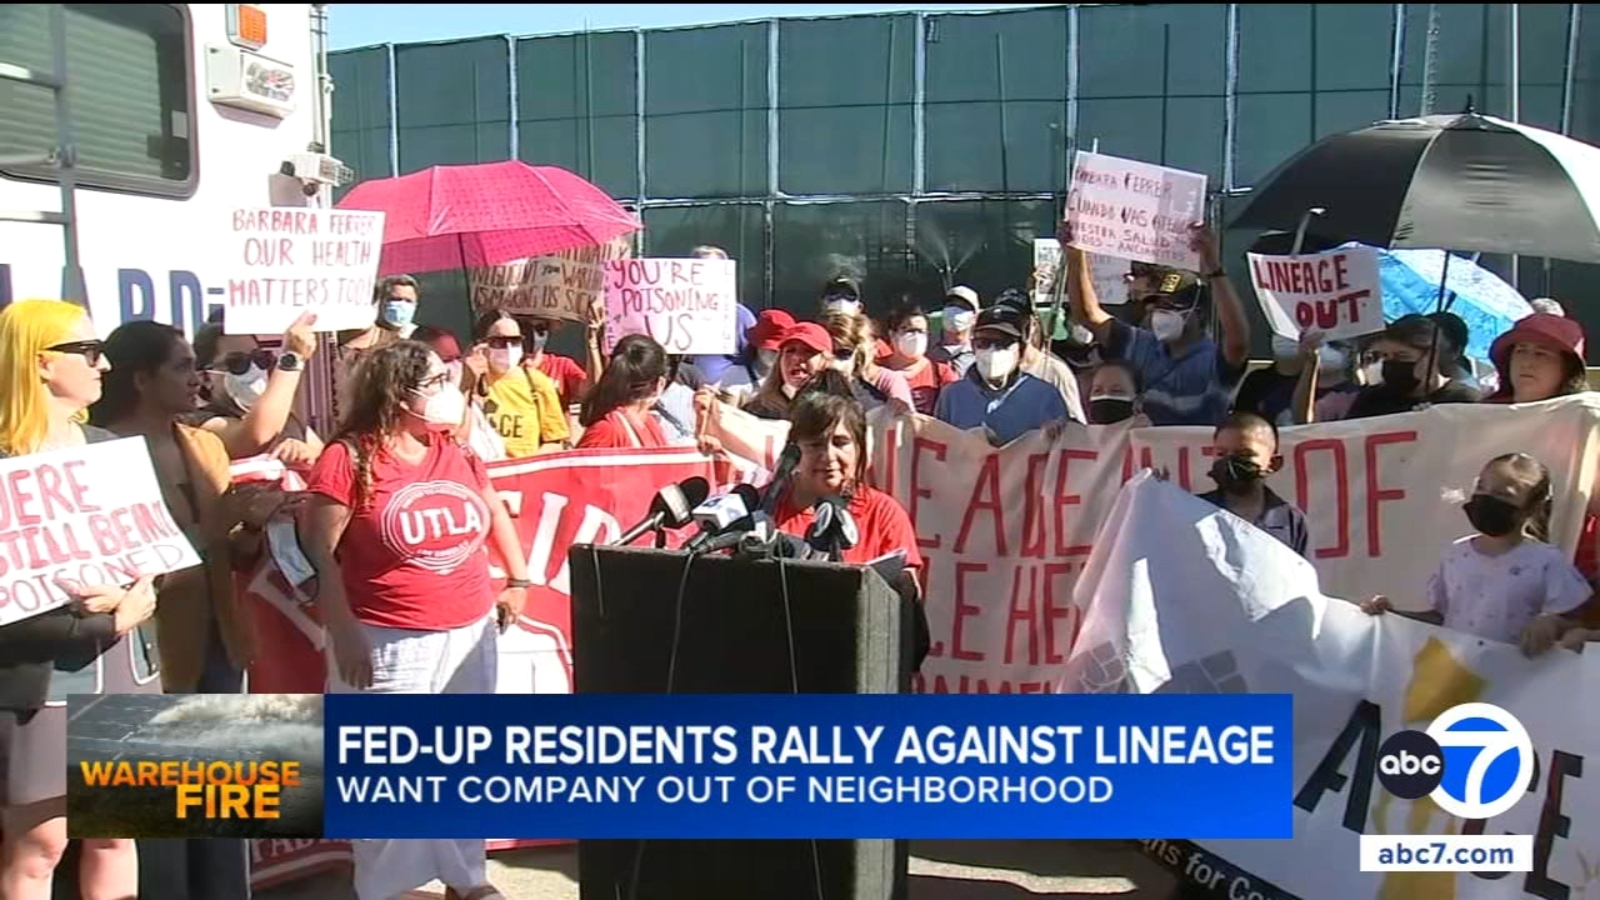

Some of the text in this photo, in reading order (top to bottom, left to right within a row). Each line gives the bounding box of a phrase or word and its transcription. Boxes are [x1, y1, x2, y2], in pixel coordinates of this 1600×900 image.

[232, 208, 319, 235] BARBARA
[243, 237, 371, 268] OUR HEALTH
[229, 278, 329, 307] MATTERS
[611, 260, 704, 289] YOU'RE
[1253, 254, 1350, 294] LINEAGE
[621, 288, 719, 317] POISONING
[1295, 289, 1371, 330] OUT
[643, 313, 693, 352] US
[1292, 431, 1418, 558] OF
[400, 501, 482, 545] UTLA
[1184, 852, 1226, 890] for
